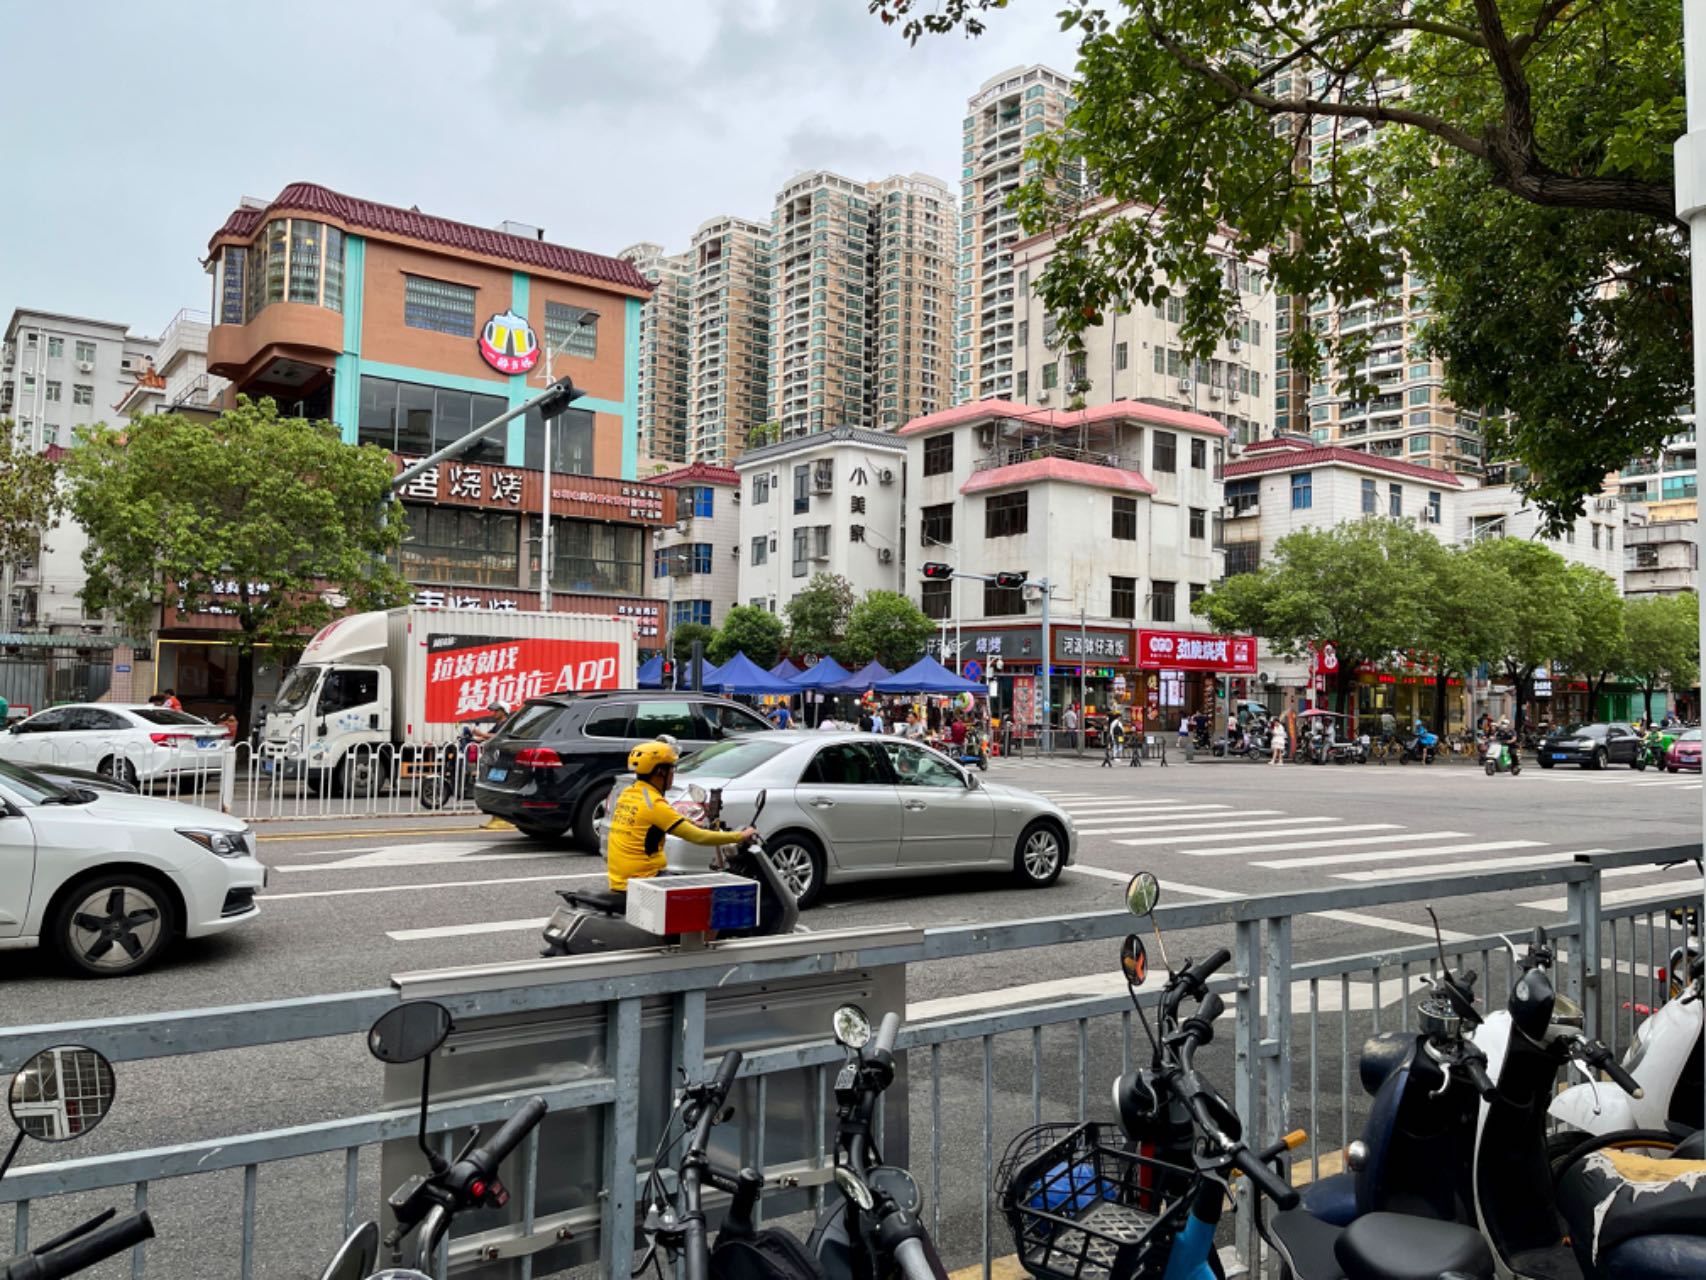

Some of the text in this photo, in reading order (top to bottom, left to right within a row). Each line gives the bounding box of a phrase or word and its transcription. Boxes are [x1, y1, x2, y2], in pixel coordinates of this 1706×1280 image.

[431, 646, 519, 683] 拉货就找
[554, 657, 616, 691] APP
